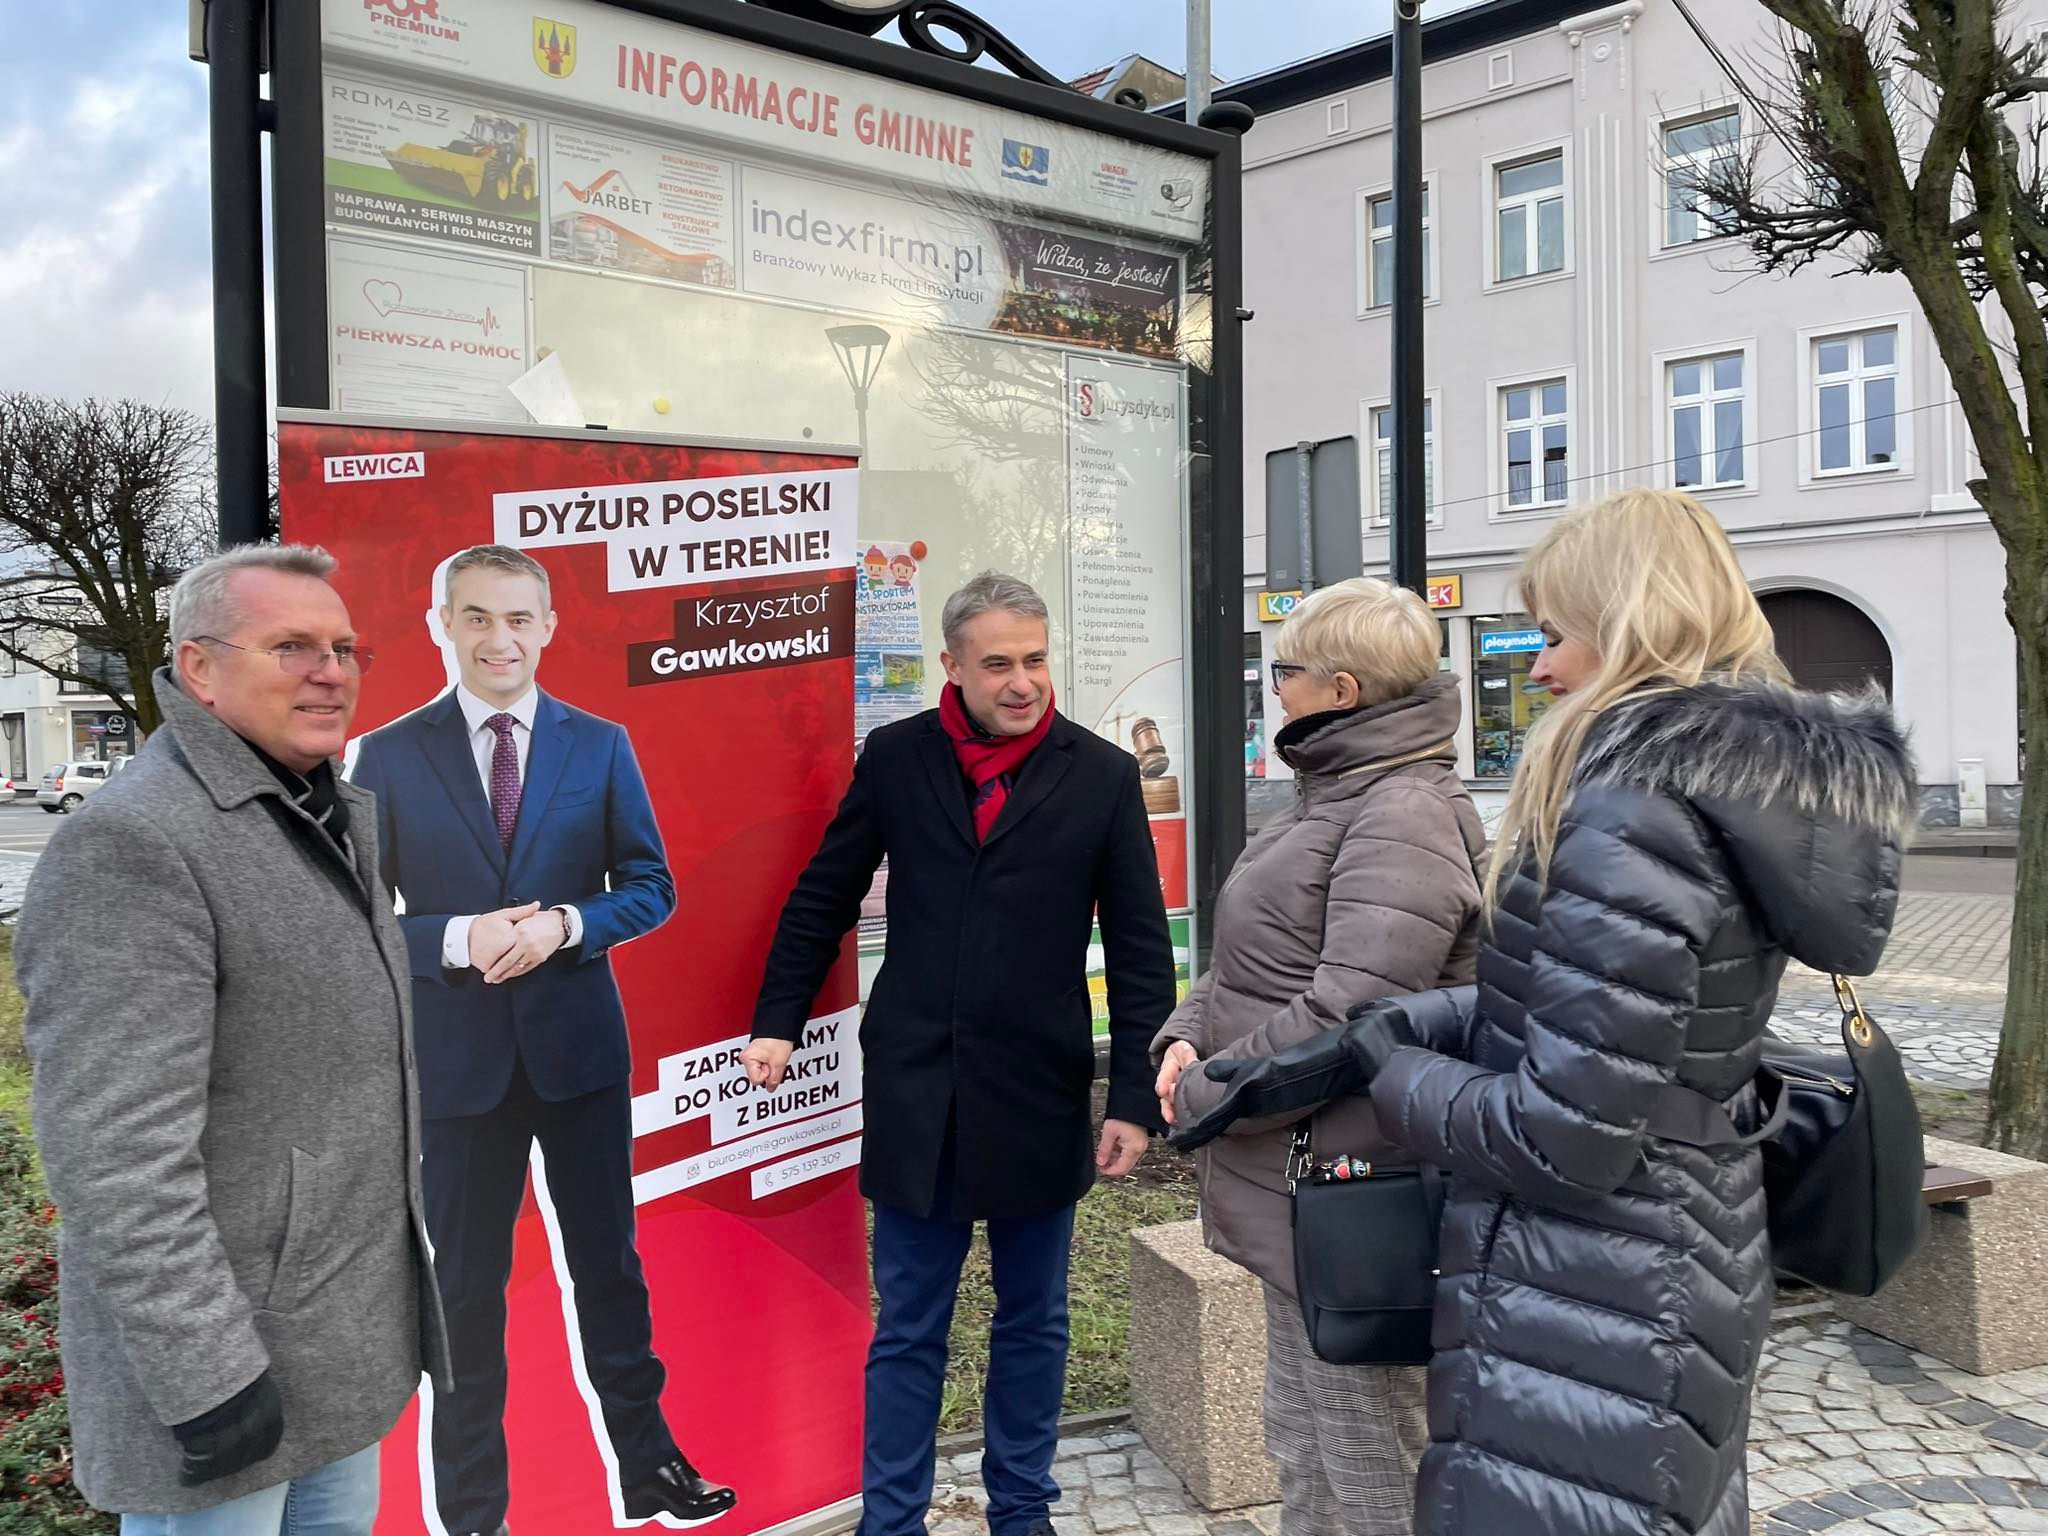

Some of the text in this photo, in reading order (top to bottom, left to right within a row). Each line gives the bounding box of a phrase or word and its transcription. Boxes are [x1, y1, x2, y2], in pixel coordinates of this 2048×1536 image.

[370, 11, 460, 42] PREMIUM
[332, 85, 450, 122] ROMASZ
[617, 44, 975, 168] INFORMACJE GMINNE
[334, 192, 533, 237] NAPRAWA SERWIS MASZYN
[583, 190, 653, 216] JARBET
[334, 206, 533, 249] BUDOWLANYCH I ROLNICZYCH
[751, 199, 983, 283] indexfirm.pl
[753, 249, 827, 277] Branżowy
[830, 263, 878, 283] Wykaz
[880, 272, 912, 290] Firm
[923, 279, 984, 305] Instytucji
[1095, 256, 1112, 275] że
[1111, 261, 1173, 288] jesteś!
[335, 325, 522, 361] PIERWSZA POMOC
[1100, 395, 1176, 422] jurysdyk.pl
[1080, 445, 1114, 458] Umowy
[1080, 460, 1116, 472] Wnioski
[329, 456, 421, 479] LEWICA
[519, 481, 832, 538] DYŻUR POSELSKI
[1081, 504, 1111, 516] Ugody
[629, 530, 831, 579] W TERENIE!
[873, 587, 915, 600] SPORTEM
[1082, 575, 1132, 588] Ponaglenia
[1082, 590, 1149, 602] Powiadomienia
[695, 585, 830, 628] Krzysztof
[1083, 604, 1147, 616] Unieważnienia
[1083, 619, 1145, 631] Upoważnienia
[1083, 633, 1150, 645] Zawiadomienia
[650, 628, 830, 676] Gawkowski
[1083, 647, 1128, 658] Wezwania
[1485, 633, 1543, 650] playmobil
[1084, 662, 1113, 673] Pozwy
[1085, 676, 1113, 688] Skargi
[683, 1021, 840, 1082] ZAPRMY
[675, 1051, 839, 1116] DO KOAKTU
[736, 1081, 839, 1127] Z BIUREM
[708, 1119, 842, 1169] biuro.sejm@gawkowski.pl
[781, 1151, 841, 1180] 575 139 309
